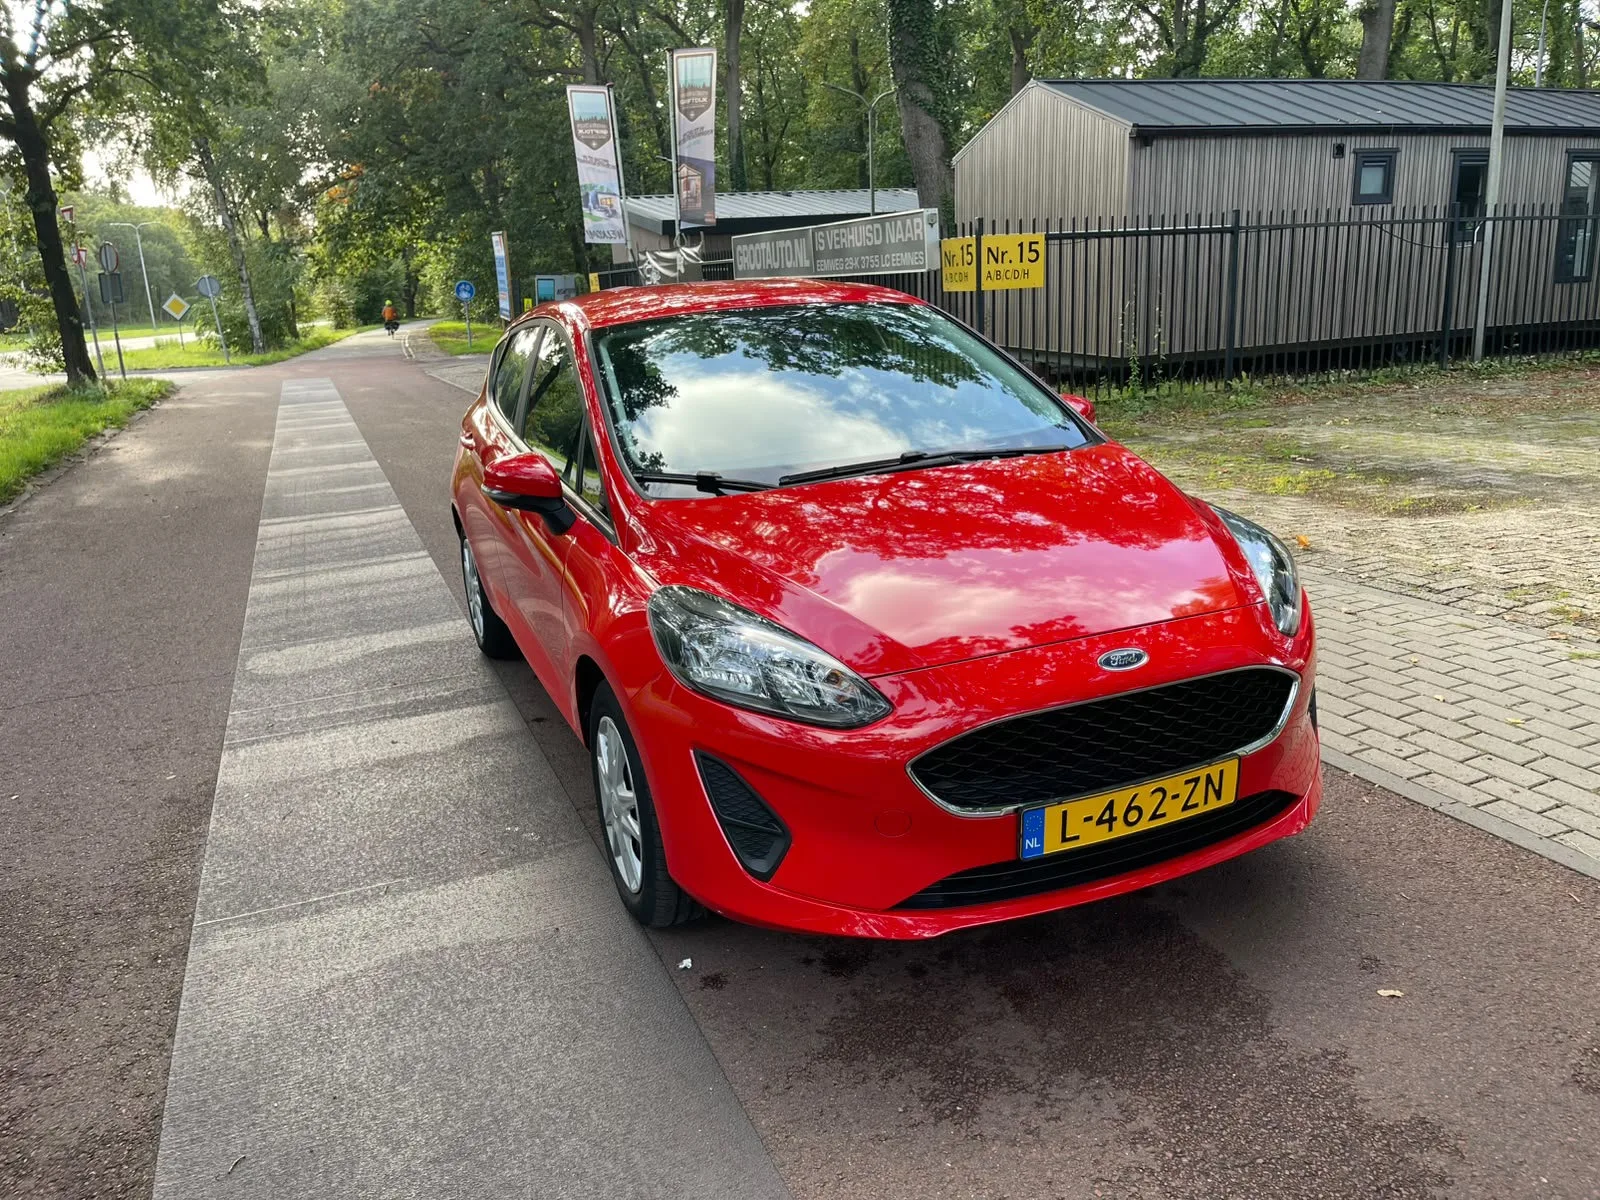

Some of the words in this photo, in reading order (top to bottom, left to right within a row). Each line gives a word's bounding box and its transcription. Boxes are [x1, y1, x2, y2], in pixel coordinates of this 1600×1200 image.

[815, 231, 825, 251] IS
[826, 223, 882, 250] VERHUISD
[885, 217, 923, 244] NAAR
[735, 237, 811, 271] GROOTAUTO.NL
[816, 258, 844, 272] EEMWEG
[861, 255, 880, 269] 3755
[881, 254, 891, 267] LC
[891, 251, 925, 266] EEMNES
[944, 250, 959, 268] Nr.
[961, 243, 974, 267] 15
[987, 246, 1013, 265] Nr.
[1018, 241, 1040, 263] 15
[1110, 652, 1138, 666] Ford
[1061, 769, 1224, 843] L-462-ZN
[1025, 837, 1041, 850] NL
